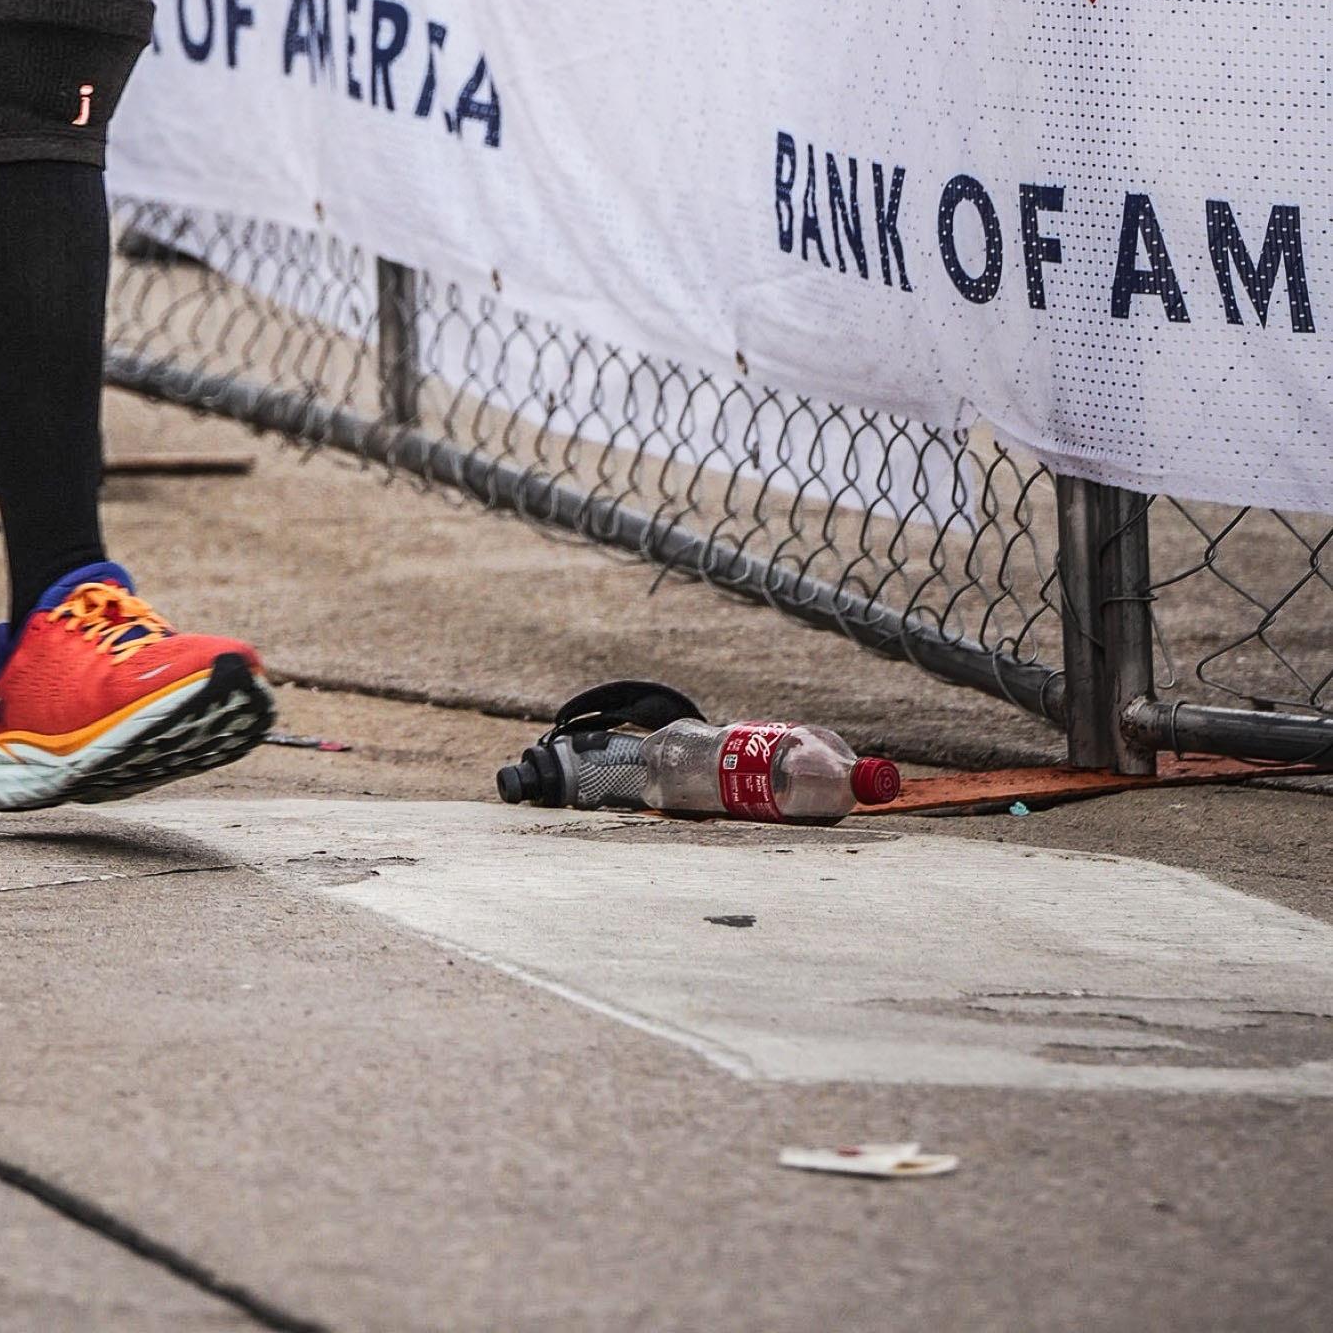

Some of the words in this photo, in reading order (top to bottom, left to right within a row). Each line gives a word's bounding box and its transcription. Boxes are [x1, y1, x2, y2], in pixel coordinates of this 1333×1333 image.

[774, 130, 914, 293] BANK
[937, 173, 1067, 311] OF
[1110, 192, 1317, 334] AM
